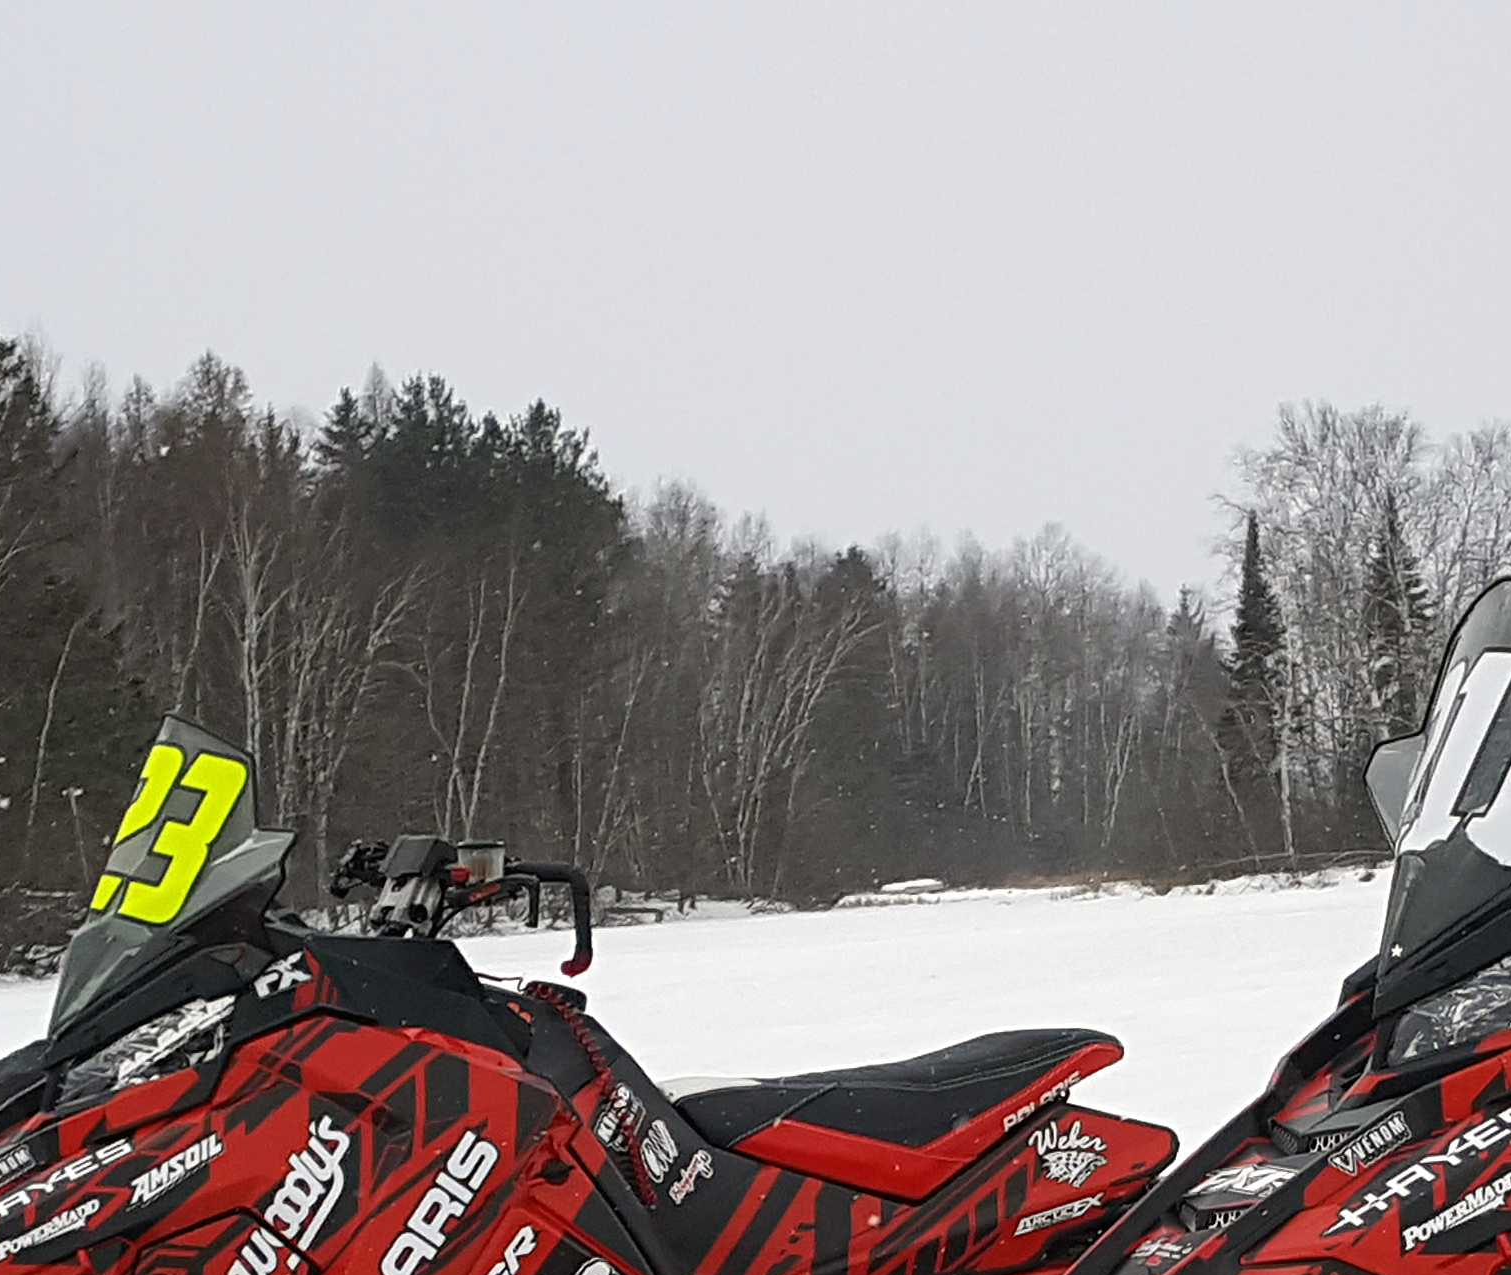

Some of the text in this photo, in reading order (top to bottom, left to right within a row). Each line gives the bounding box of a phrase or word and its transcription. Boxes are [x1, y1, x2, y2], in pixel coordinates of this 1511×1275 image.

[1028, 1120, 1107, 1155] Weber
[1352, 1113, 1407, 1162] VENOM
[129, 1132, 223, 1206] AMSOIL
